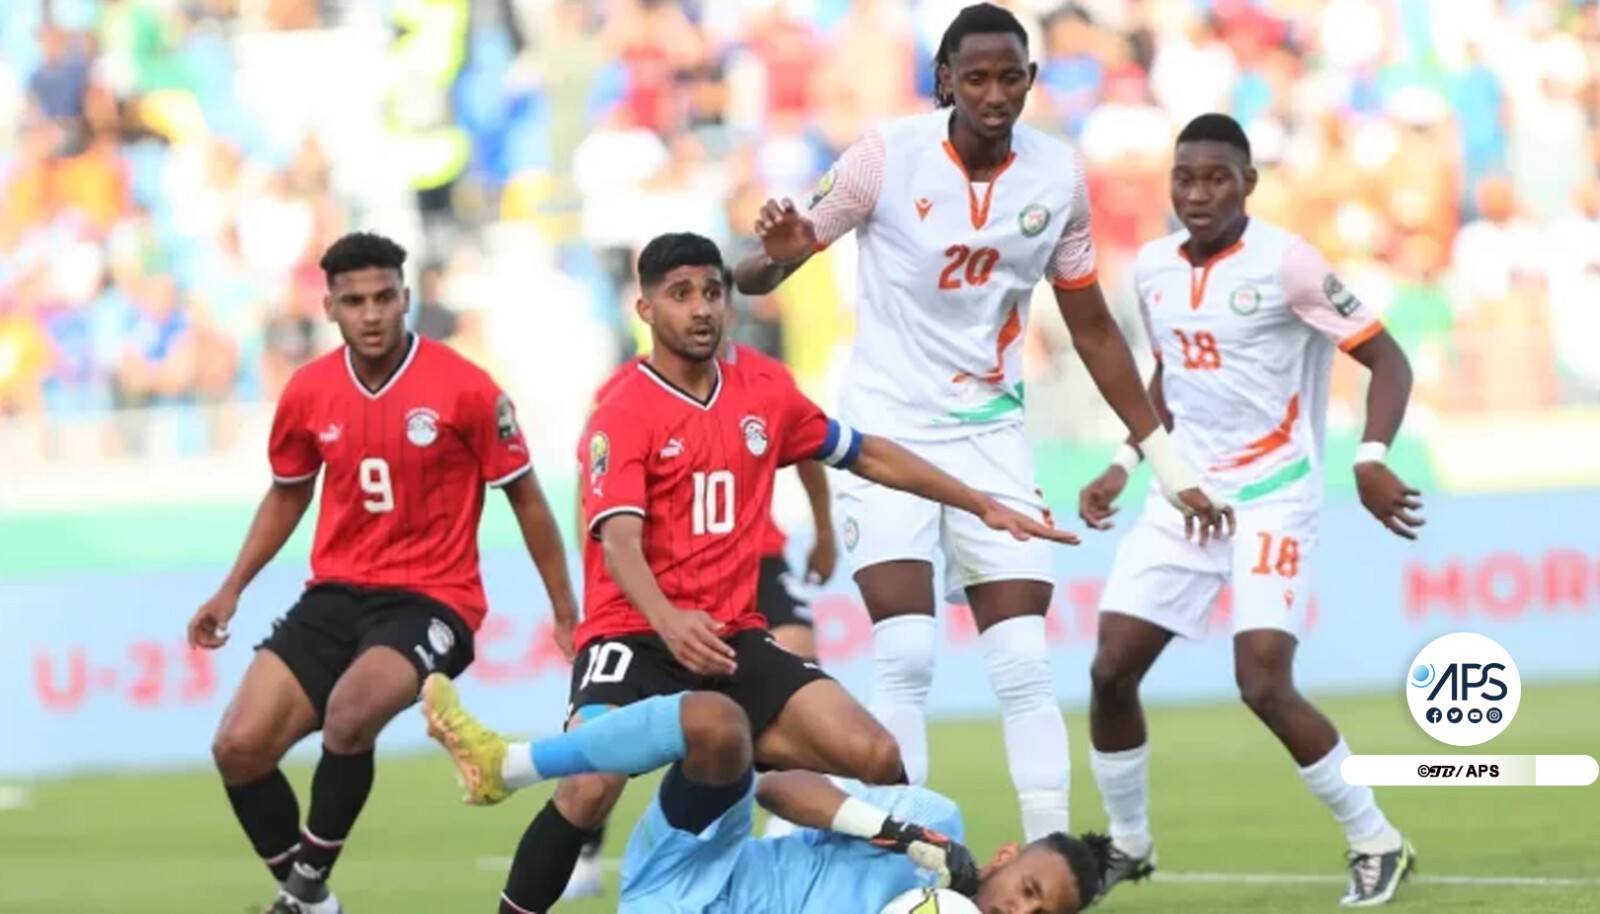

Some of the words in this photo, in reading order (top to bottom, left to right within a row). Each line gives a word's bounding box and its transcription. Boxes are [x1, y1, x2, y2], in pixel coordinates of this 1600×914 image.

[938, 244, 1000, 290] 20
[1172, 328, 1221, 370] 18
[359, 457, 395, 513] 9
[692, 470, 736, 535] 10
[1252, 532, 1299, 577] 18
[1405, 551, 1600, 622] MOR
[579, 642, 633, 691] 10
